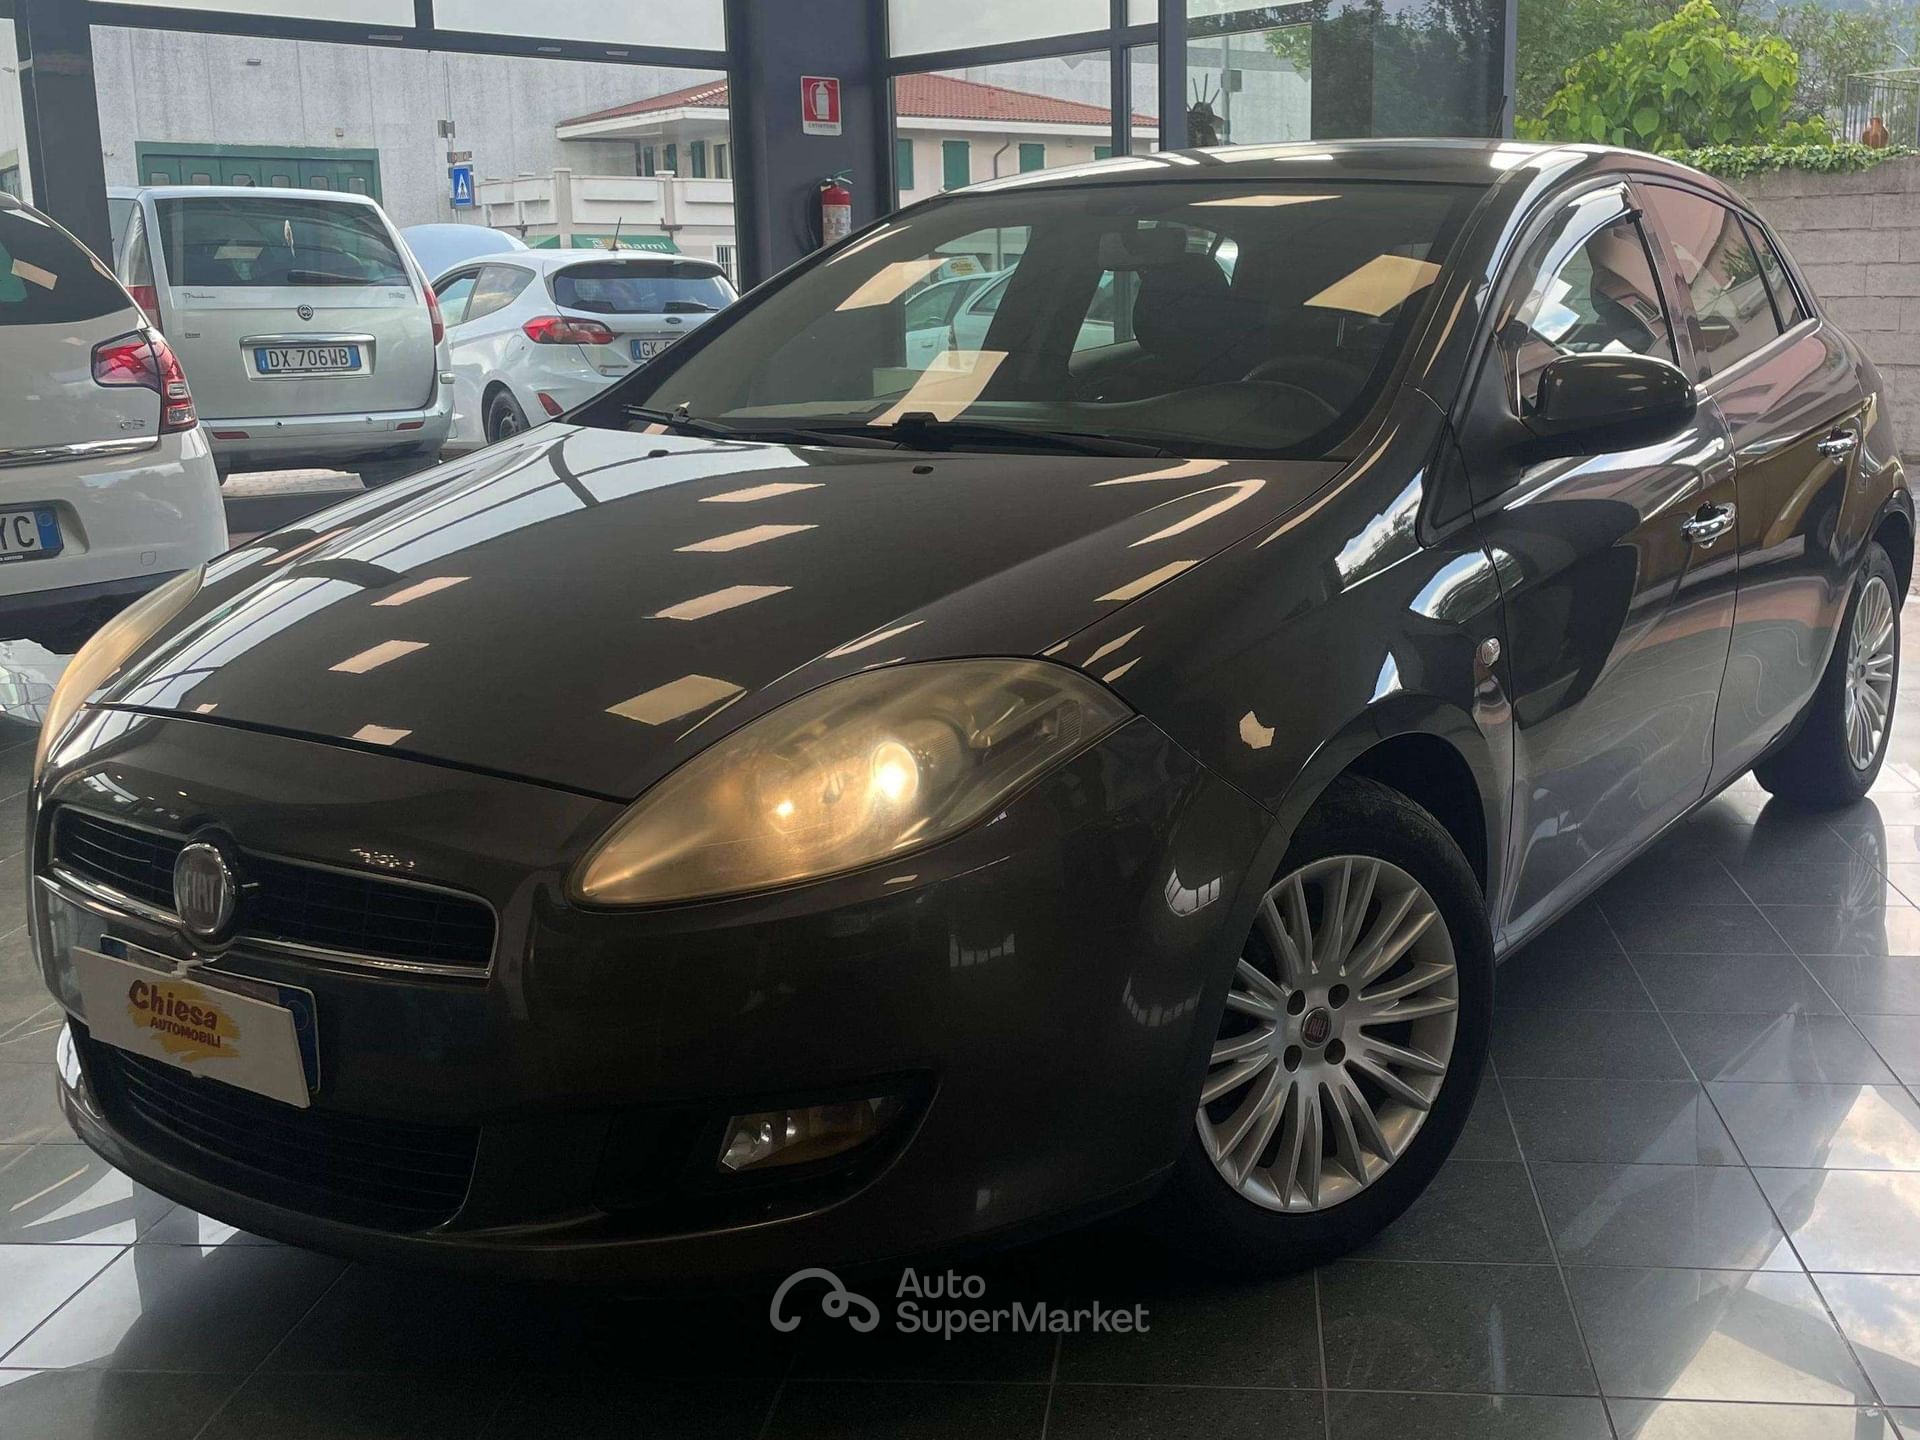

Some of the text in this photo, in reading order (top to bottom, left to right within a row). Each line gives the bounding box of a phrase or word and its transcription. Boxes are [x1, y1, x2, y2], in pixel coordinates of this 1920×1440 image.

[269, 349, 349, 367] DX 706WB
[641, 342, 657, 356] GK
[128, 979, 218, 1031] Chiesa
[150, 1015, 221, 1049] AUTOMOBILI
